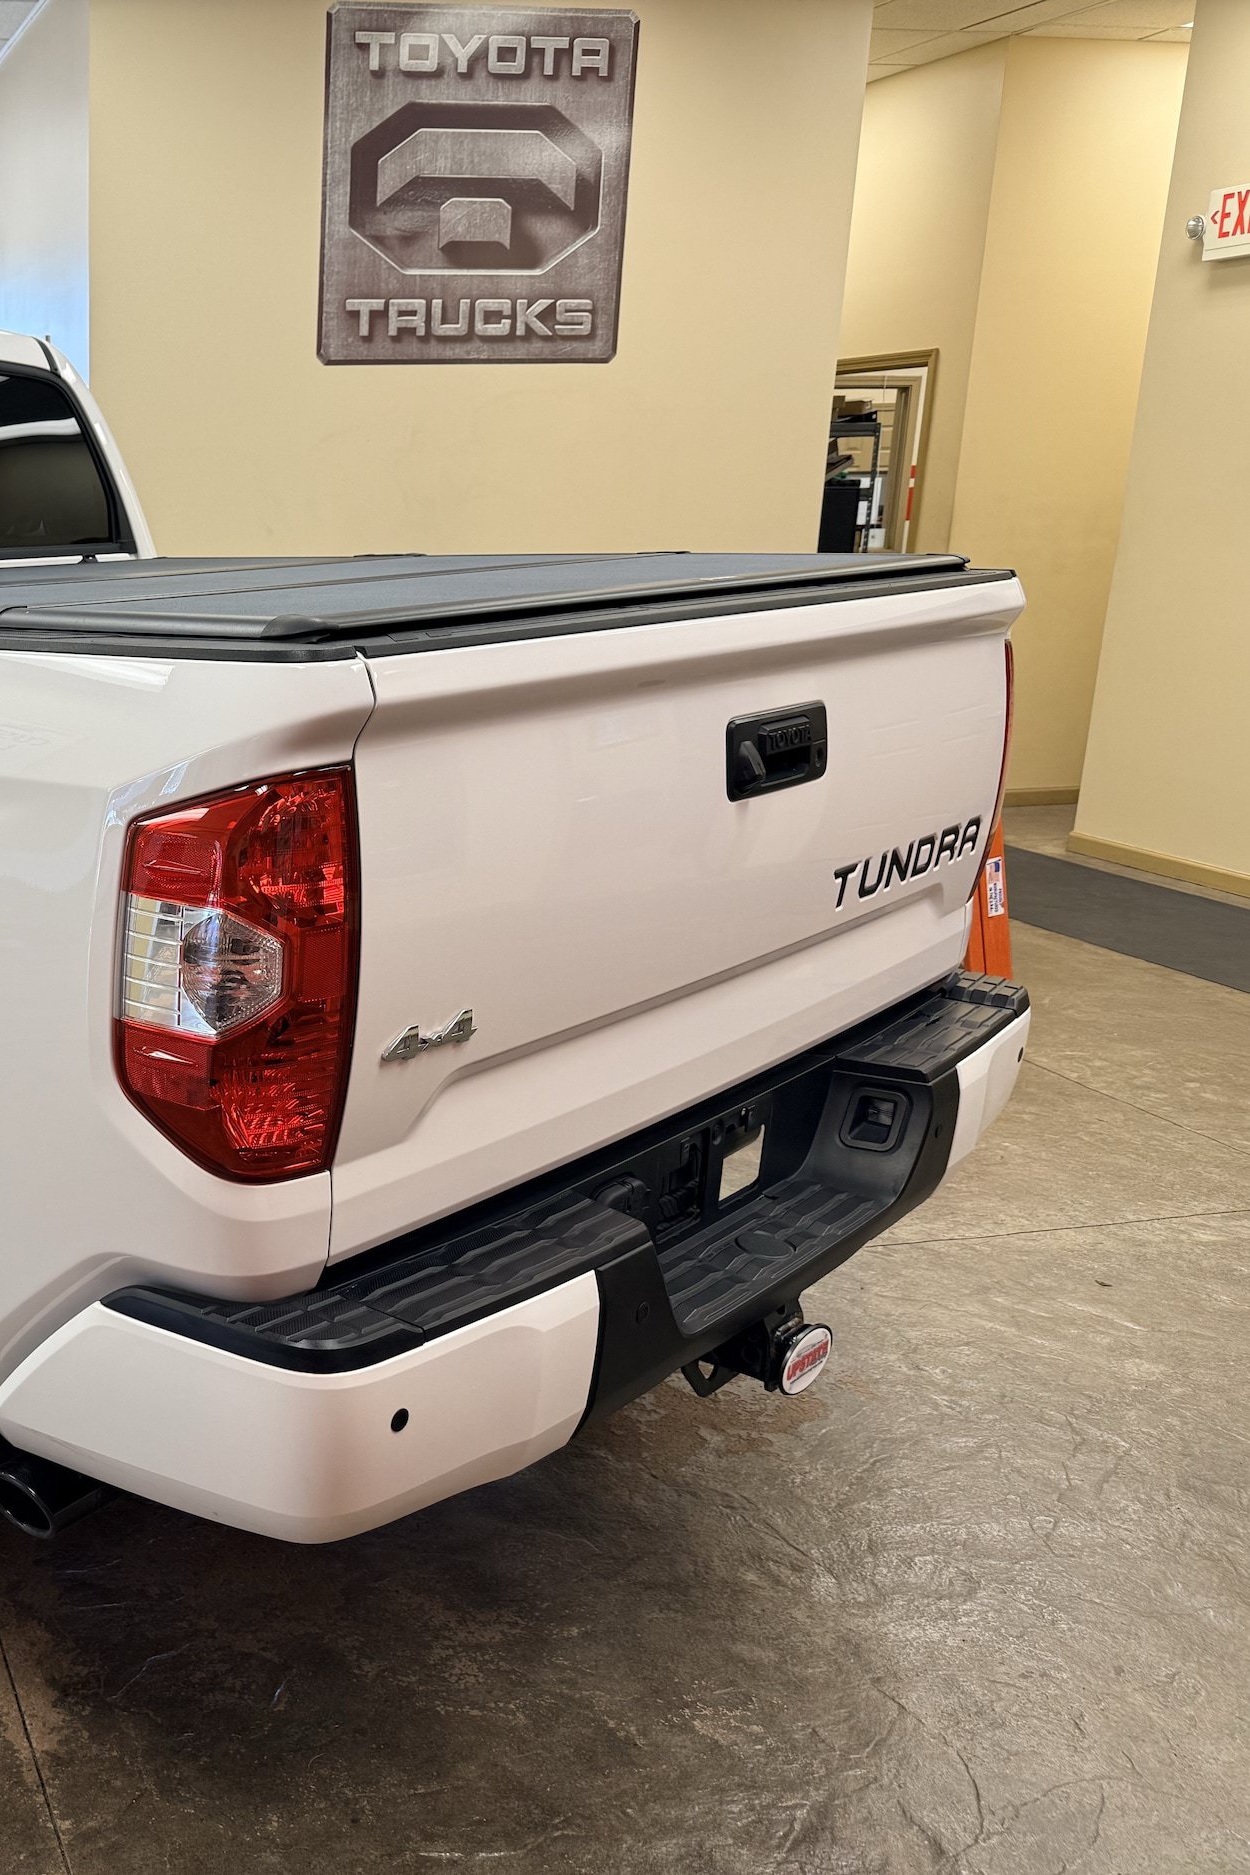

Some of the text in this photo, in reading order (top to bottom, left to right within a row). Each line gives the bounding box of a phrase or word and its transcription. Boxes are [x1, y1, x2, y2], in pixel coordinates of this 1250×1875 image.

[355, 31, 610, 77] TOYOTA
[1217, 189, 1250, 238] EX
[345, 298, 593, 337] TRUCKS
[768, 725, 811, 752] TOYOTA
[833, 815, 982, 910] TUNDRA
[786, 1339, 830, 1381] UPSTATE
